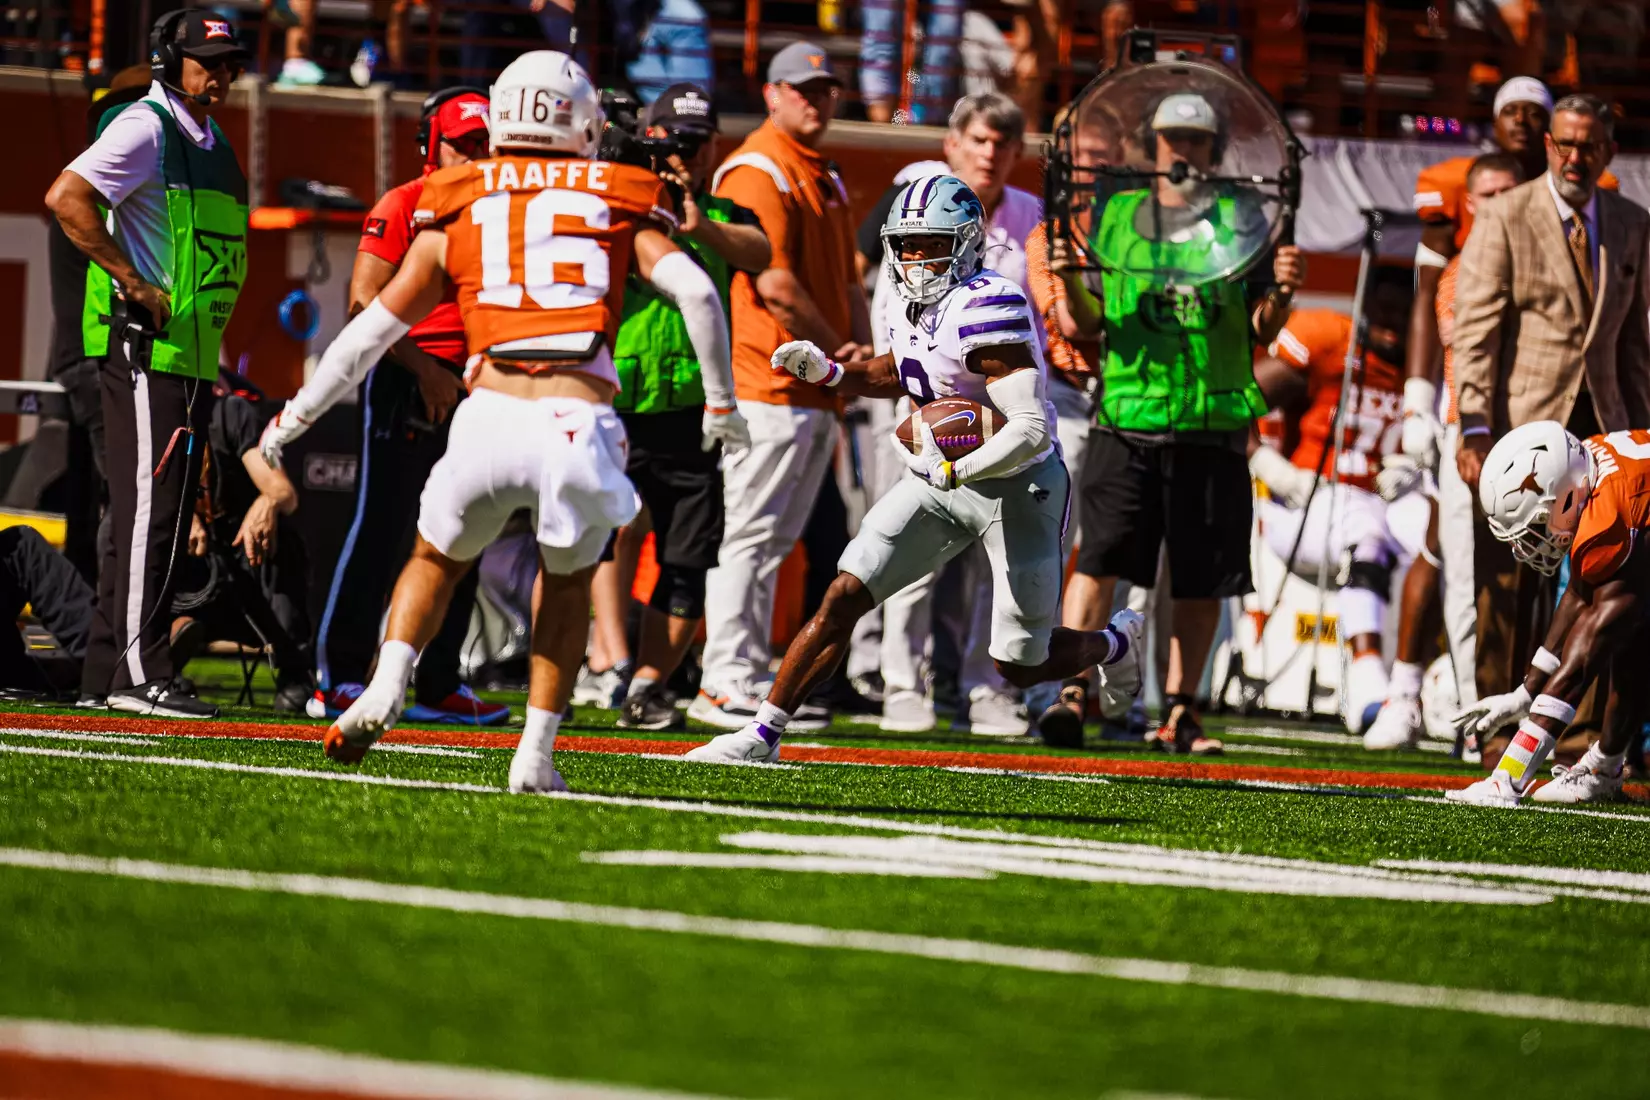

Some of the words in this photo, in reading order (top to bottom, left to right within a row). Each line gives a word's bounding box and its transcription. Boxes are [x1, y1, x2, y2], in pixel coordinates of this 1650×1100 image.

[517, 87, 550, 123] 16
[476, 161, 612, 192] TAAFFE
[470, 187, 611, 310] 16
[967, 277, 991, 291] 8
